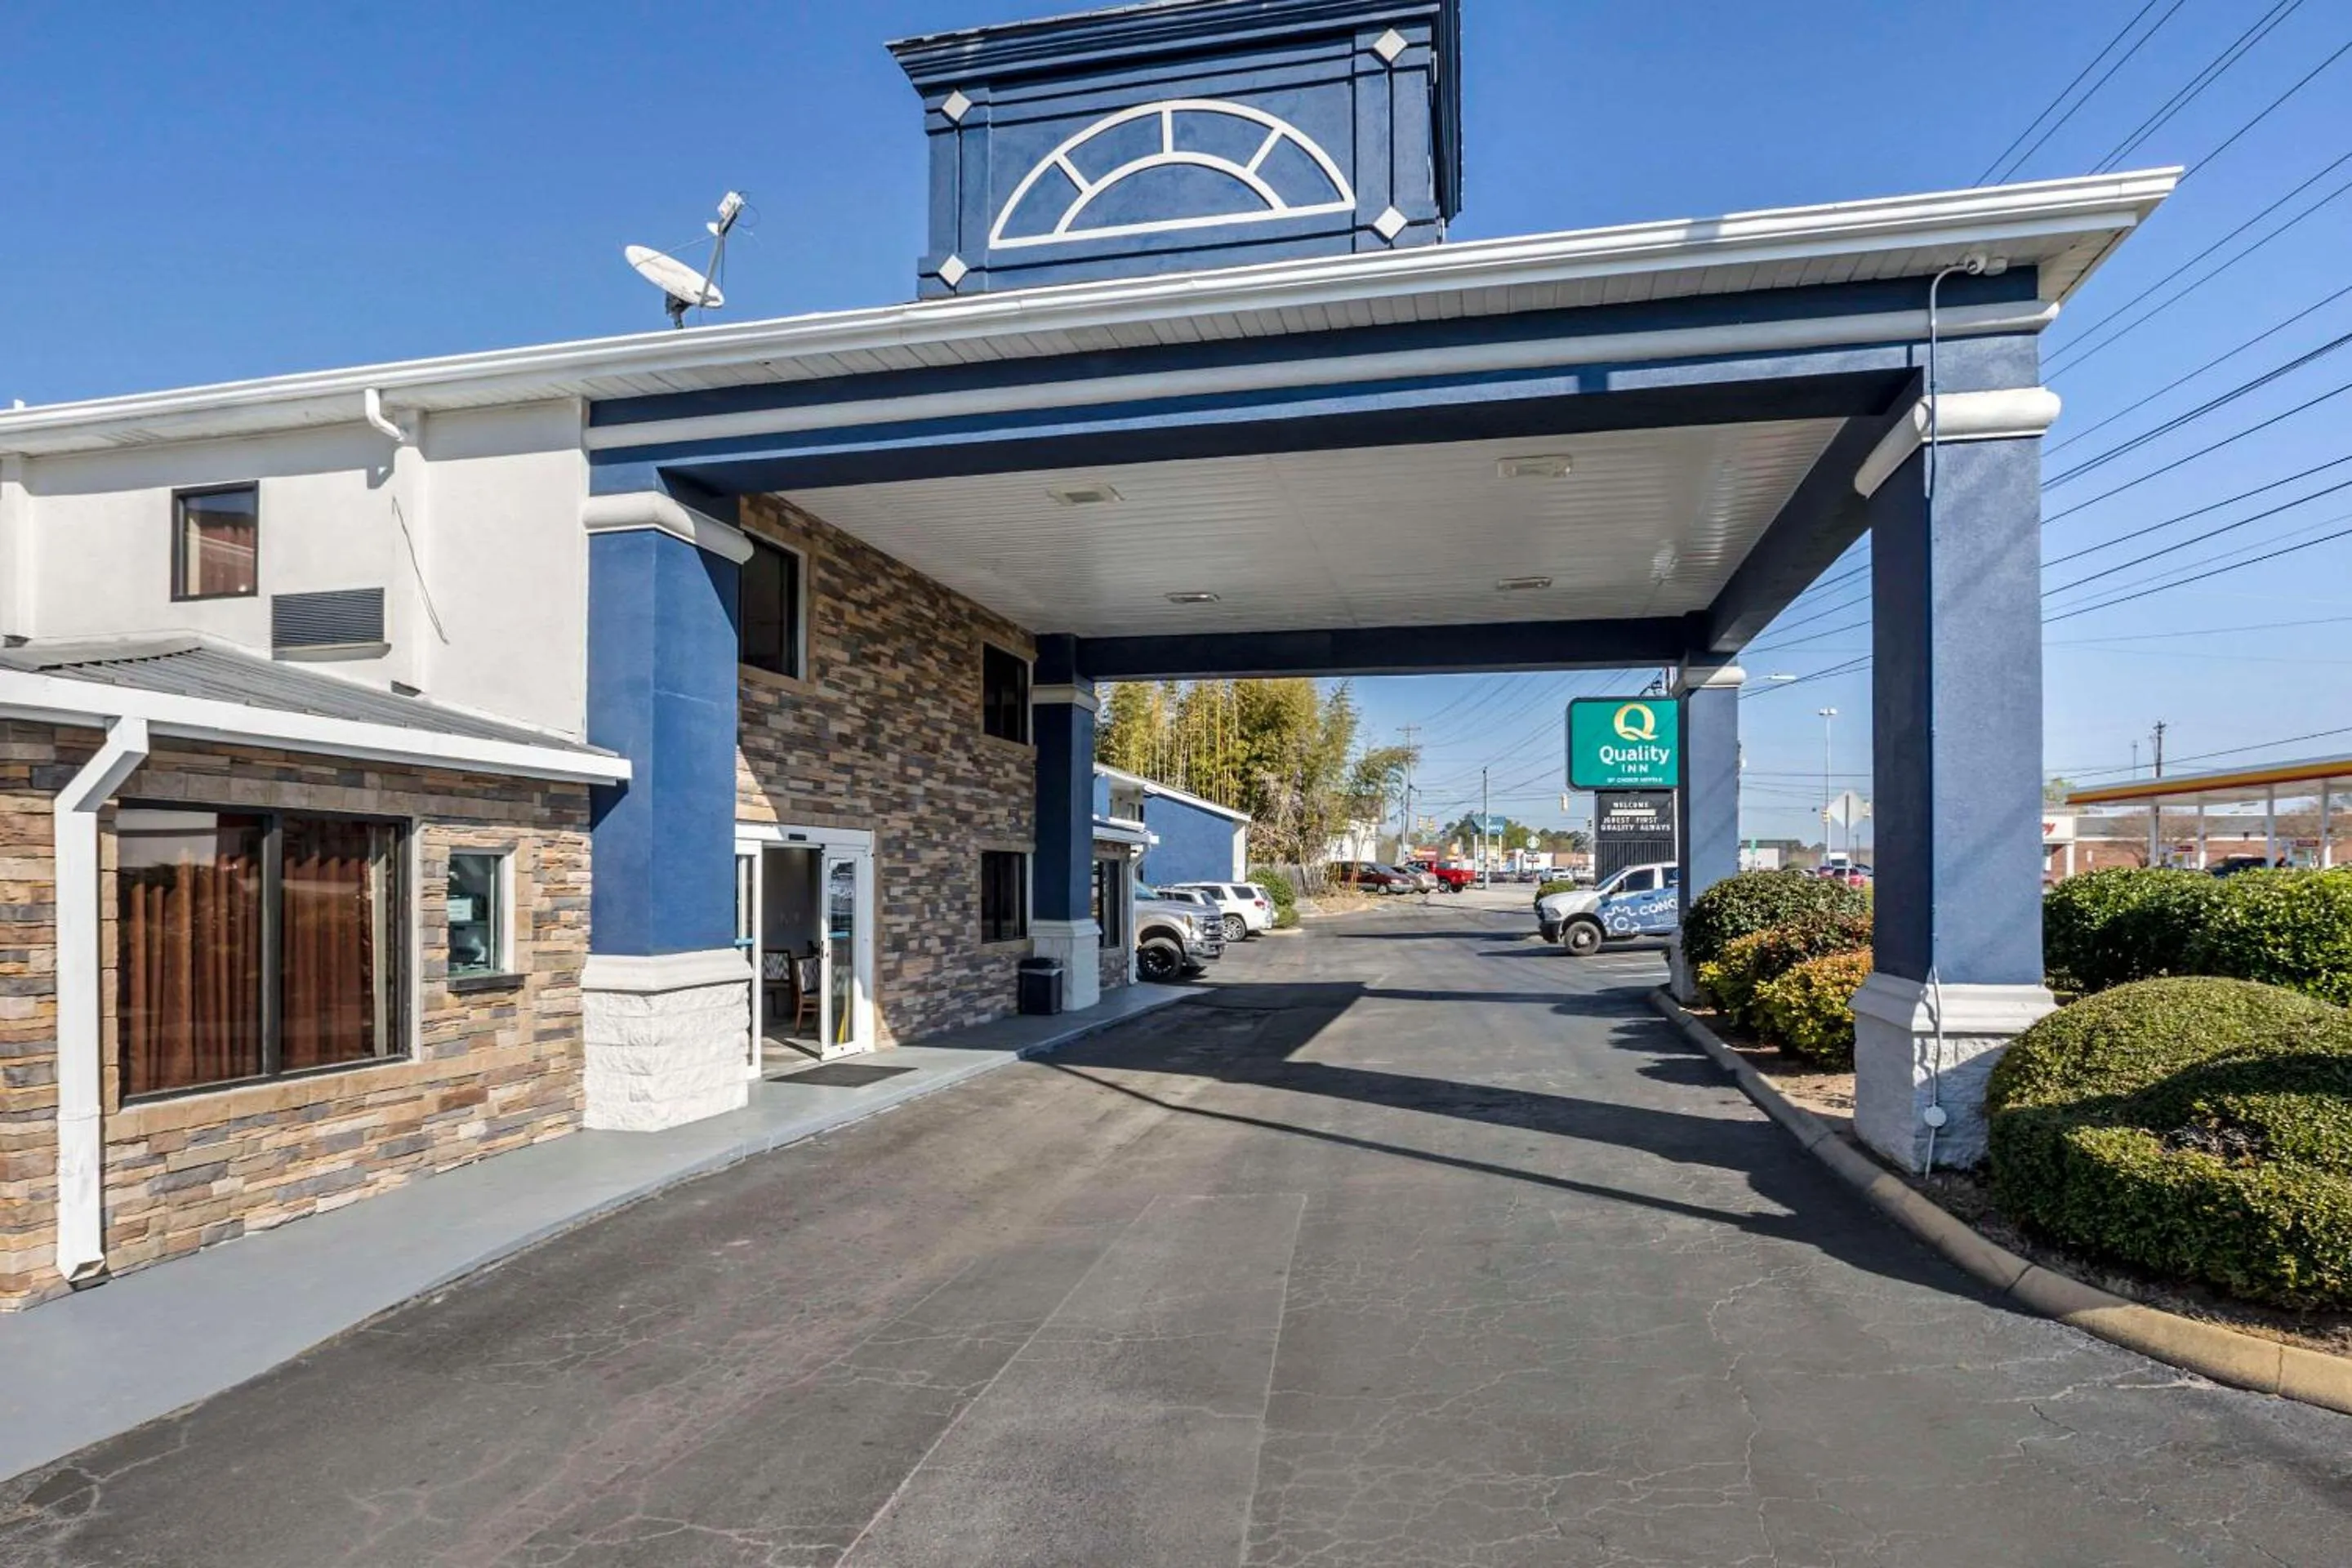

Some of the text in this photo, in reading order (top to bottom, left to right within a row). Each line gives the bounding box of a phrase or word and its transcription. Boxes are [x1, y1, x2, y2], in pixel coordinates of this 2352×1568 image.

[1614, 703, 1659, 741] Q
[1599, 745, 1670, 765] Quality
[1622, 764, 1649, 773] INN
